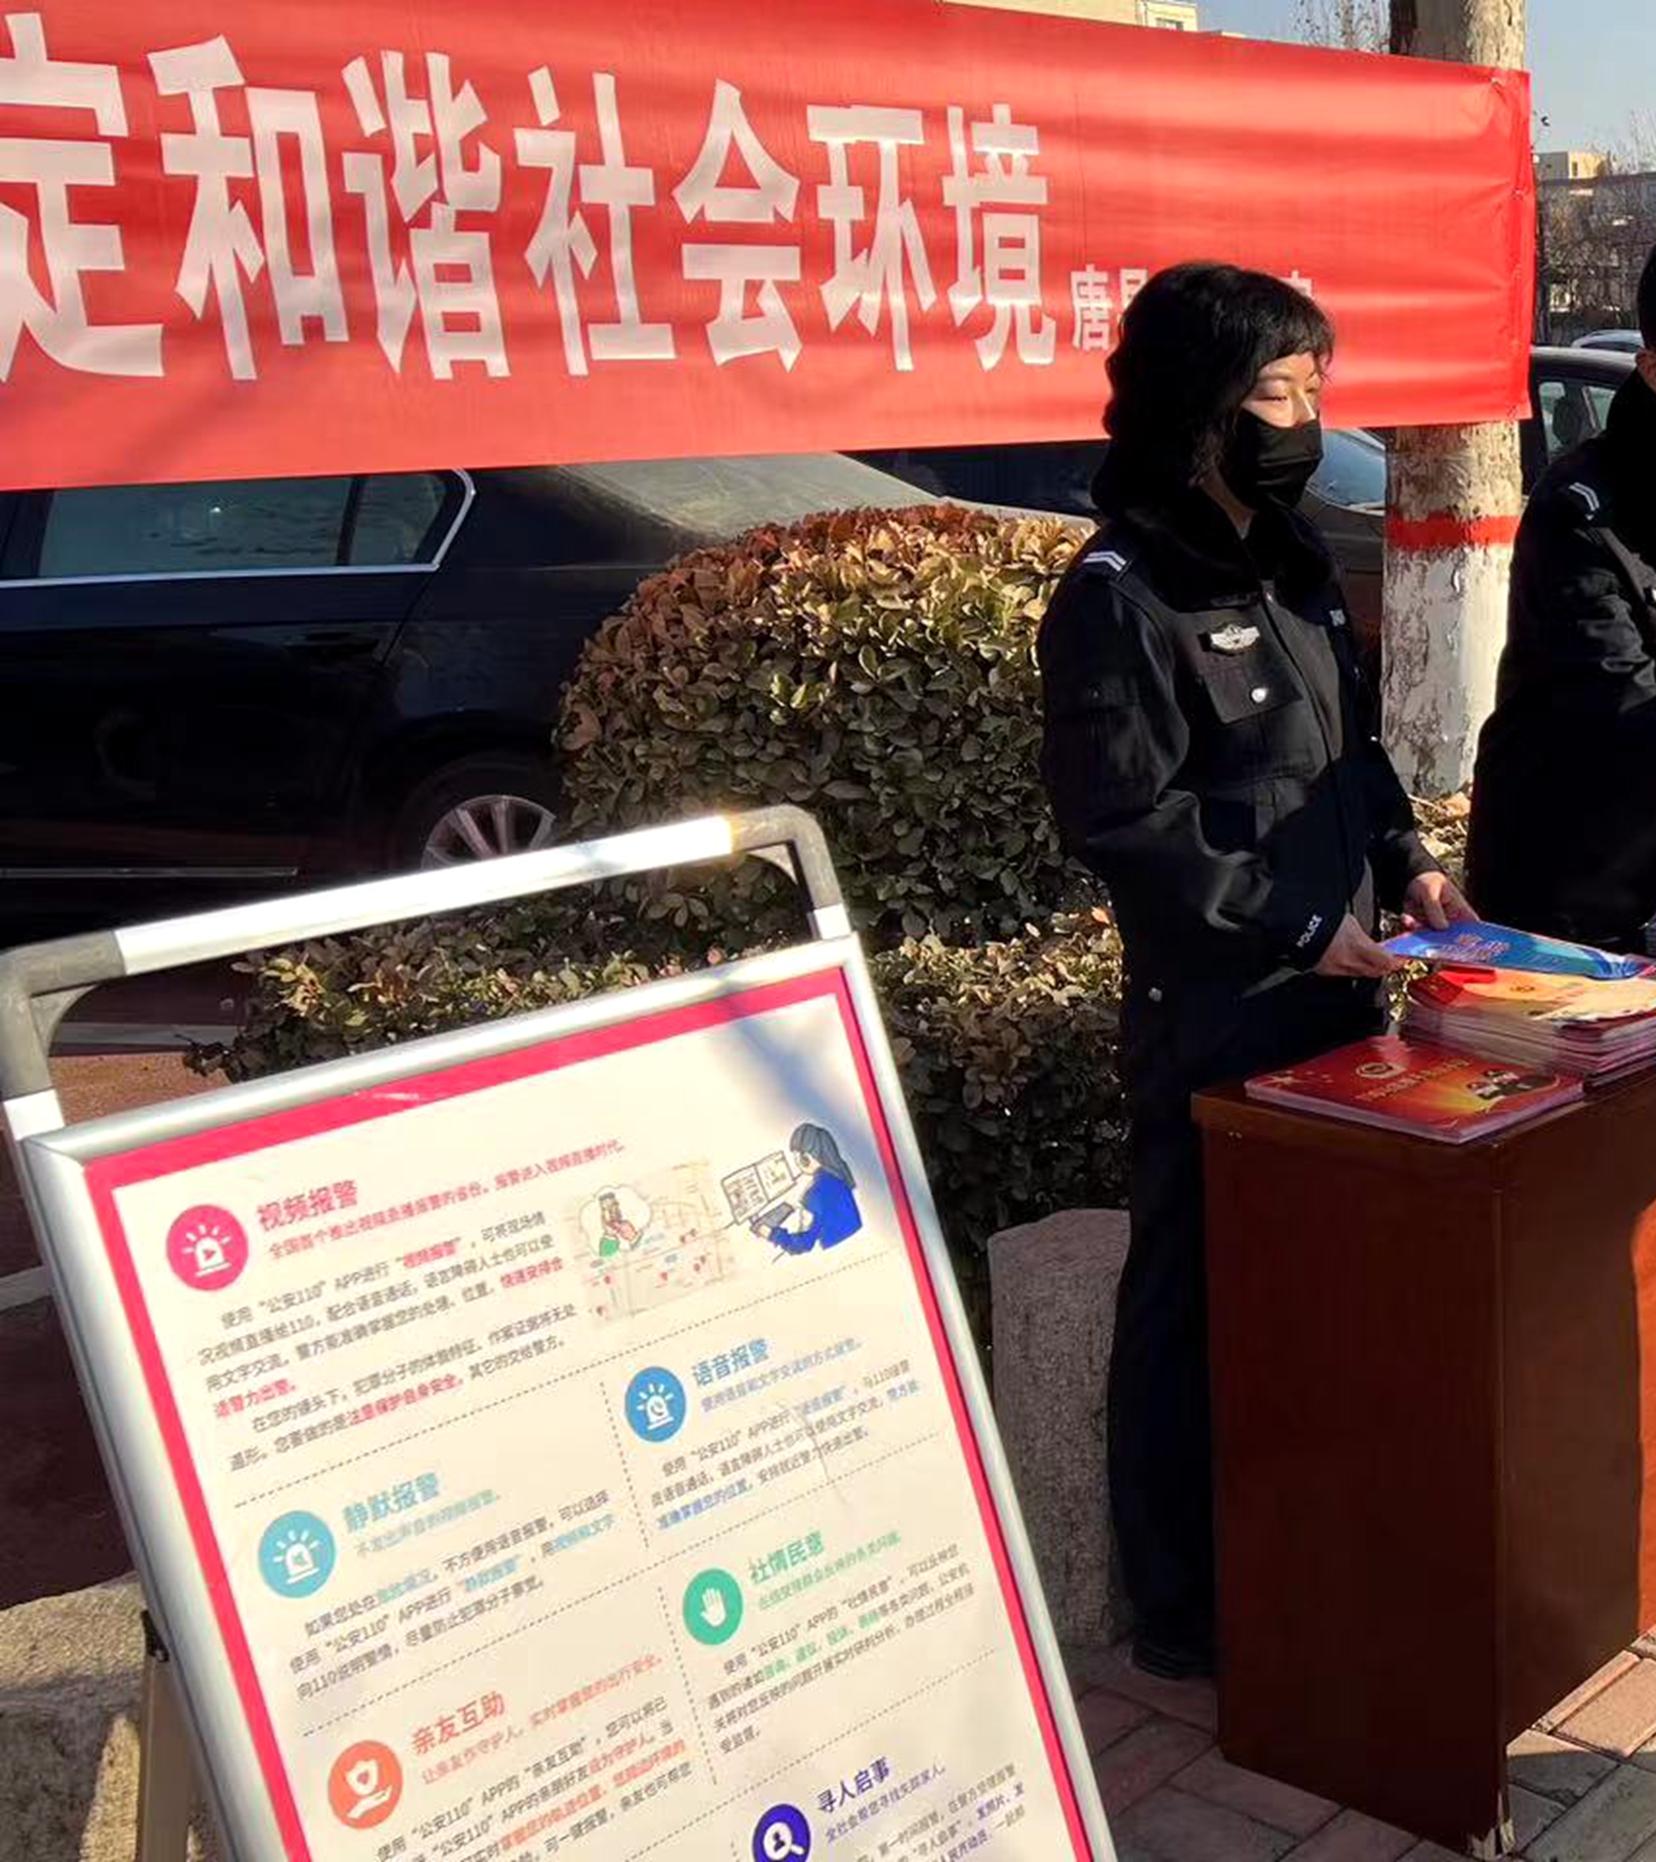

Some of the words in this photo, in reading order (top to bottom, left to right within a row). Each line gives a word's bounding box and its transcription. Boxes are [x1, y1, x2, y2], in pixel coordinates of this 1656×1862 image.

[0, 14, 1056, 381] 定和谐社会环境
[1295, 913, 1323, 948] POLICE
[257, 1181, 358, 1233] 视频报警
[691, 1339, 769, 1387] 语音报警
[344, 1474, 439, 1533] 静默报警
[749, 1532, 823, 1585] 社情民意
[413, 1692, 505, 1756] 亲友互助
[817, 1757, 890, 1815] 寻人启事
